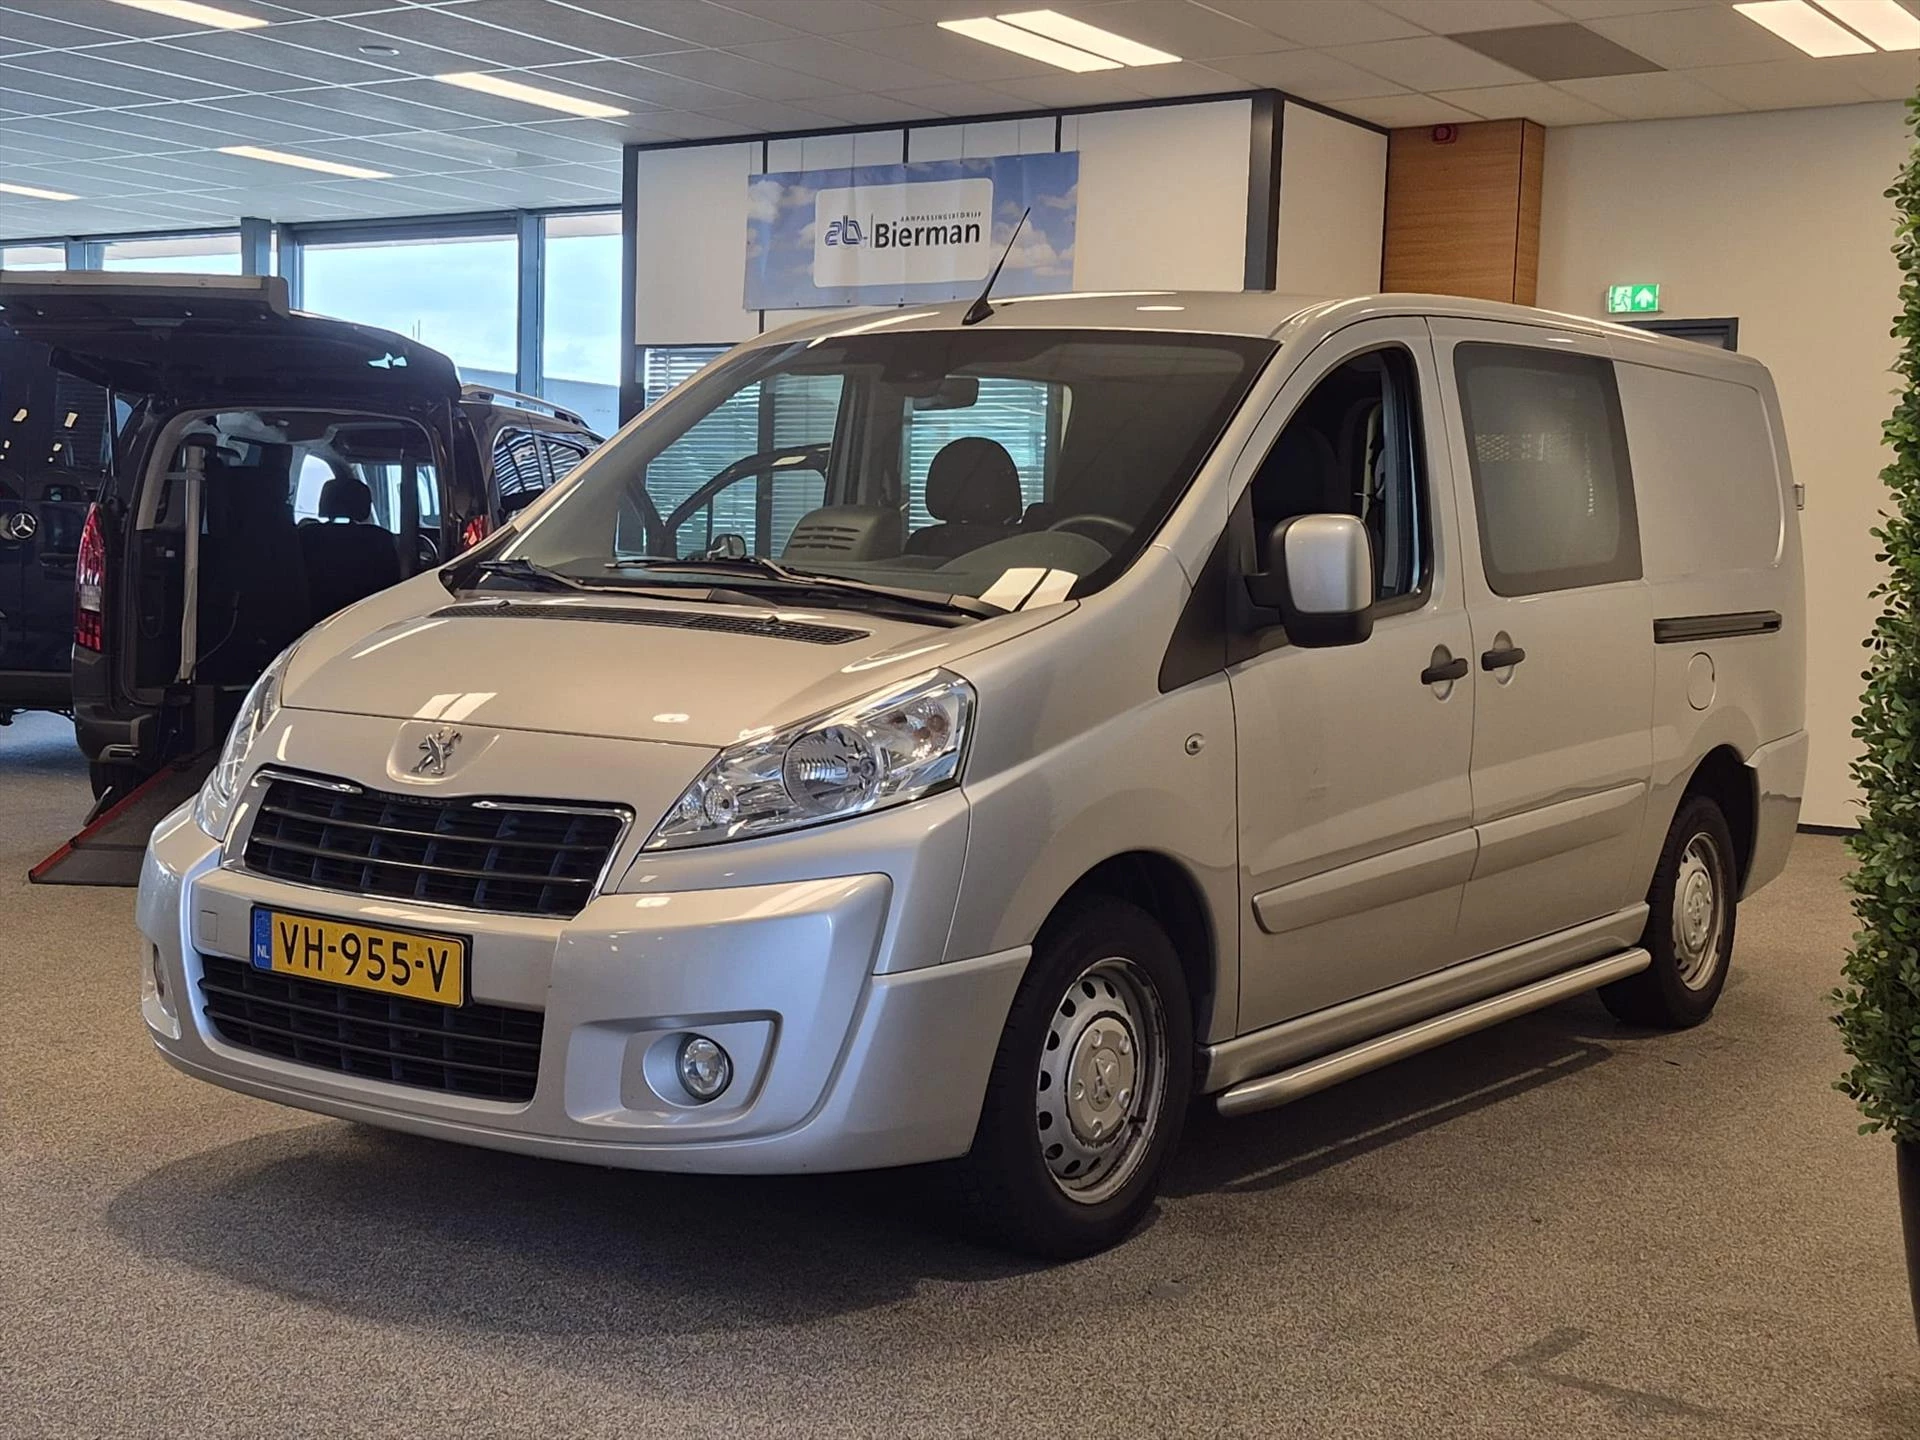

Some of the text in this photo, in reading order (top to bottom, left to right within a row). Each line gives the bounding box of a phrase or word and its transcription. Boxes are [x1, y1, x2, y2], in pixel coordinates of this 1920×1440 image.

[874, 221, 980, 248] Bierman
[257, 944, 270, 959] NL
[280, 921, 449, 992] VH-955-V
